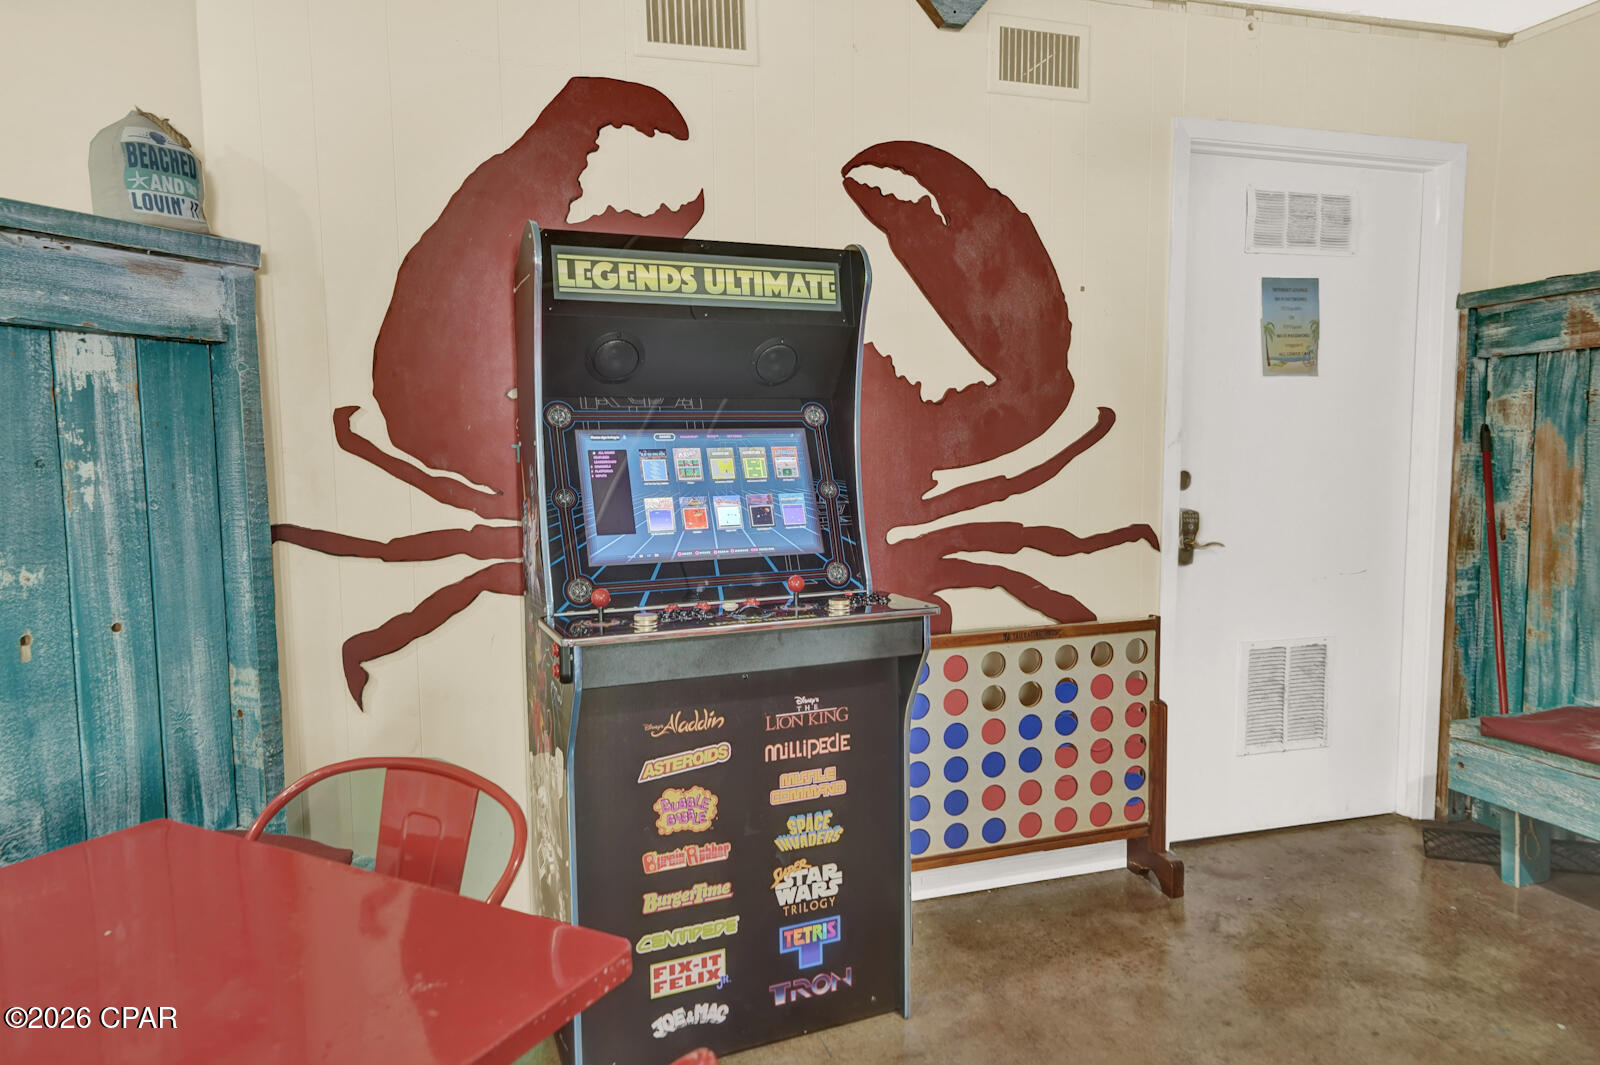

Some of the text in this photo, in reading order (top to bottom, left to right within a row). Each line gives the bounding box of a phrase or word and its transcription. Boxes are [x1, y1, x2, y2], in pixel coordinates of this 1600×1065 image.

[125, 142, 198, 180] BEACHED
[150, 173, 185, 195] AND
[130, 191, 186, 216] LOVIN'
[557, 259, 836, 300] LEGENDS ULTIMATE
[765, 706, 849, 731] LION KING
[796, 704, 819, 712] THE
[650, 708, 725, 738] Aladdin
[640, 744, 731, 781] ASTEROIDS
[779, 766, 837, 789] MISSILE
[660, 793, 711, 814] BUBBLE
[770, 780, 847, 805] COMMAND
[666, 808, 707, 827] BOBBLE
[786, 809, 833, 835] SPACE
[774, 825, 844, 852] INVADERS
[775, 863, 843, 891] STAR
[775, 877, 843, 906] WARS
[783, 896, 836, 917] TRILOGY
[636, 915, 740, 954] CENTIPEDE
[783, 920, 837, 948] TETRIS
[653, 953, 722, 980] FIX-IT
[653, 968, 721, 994] FELIX
[769, 966, 852, 1006] TRON
[651, 1006, 687, 1039] JOE
[694, 1002, 730, 1025] MAC
